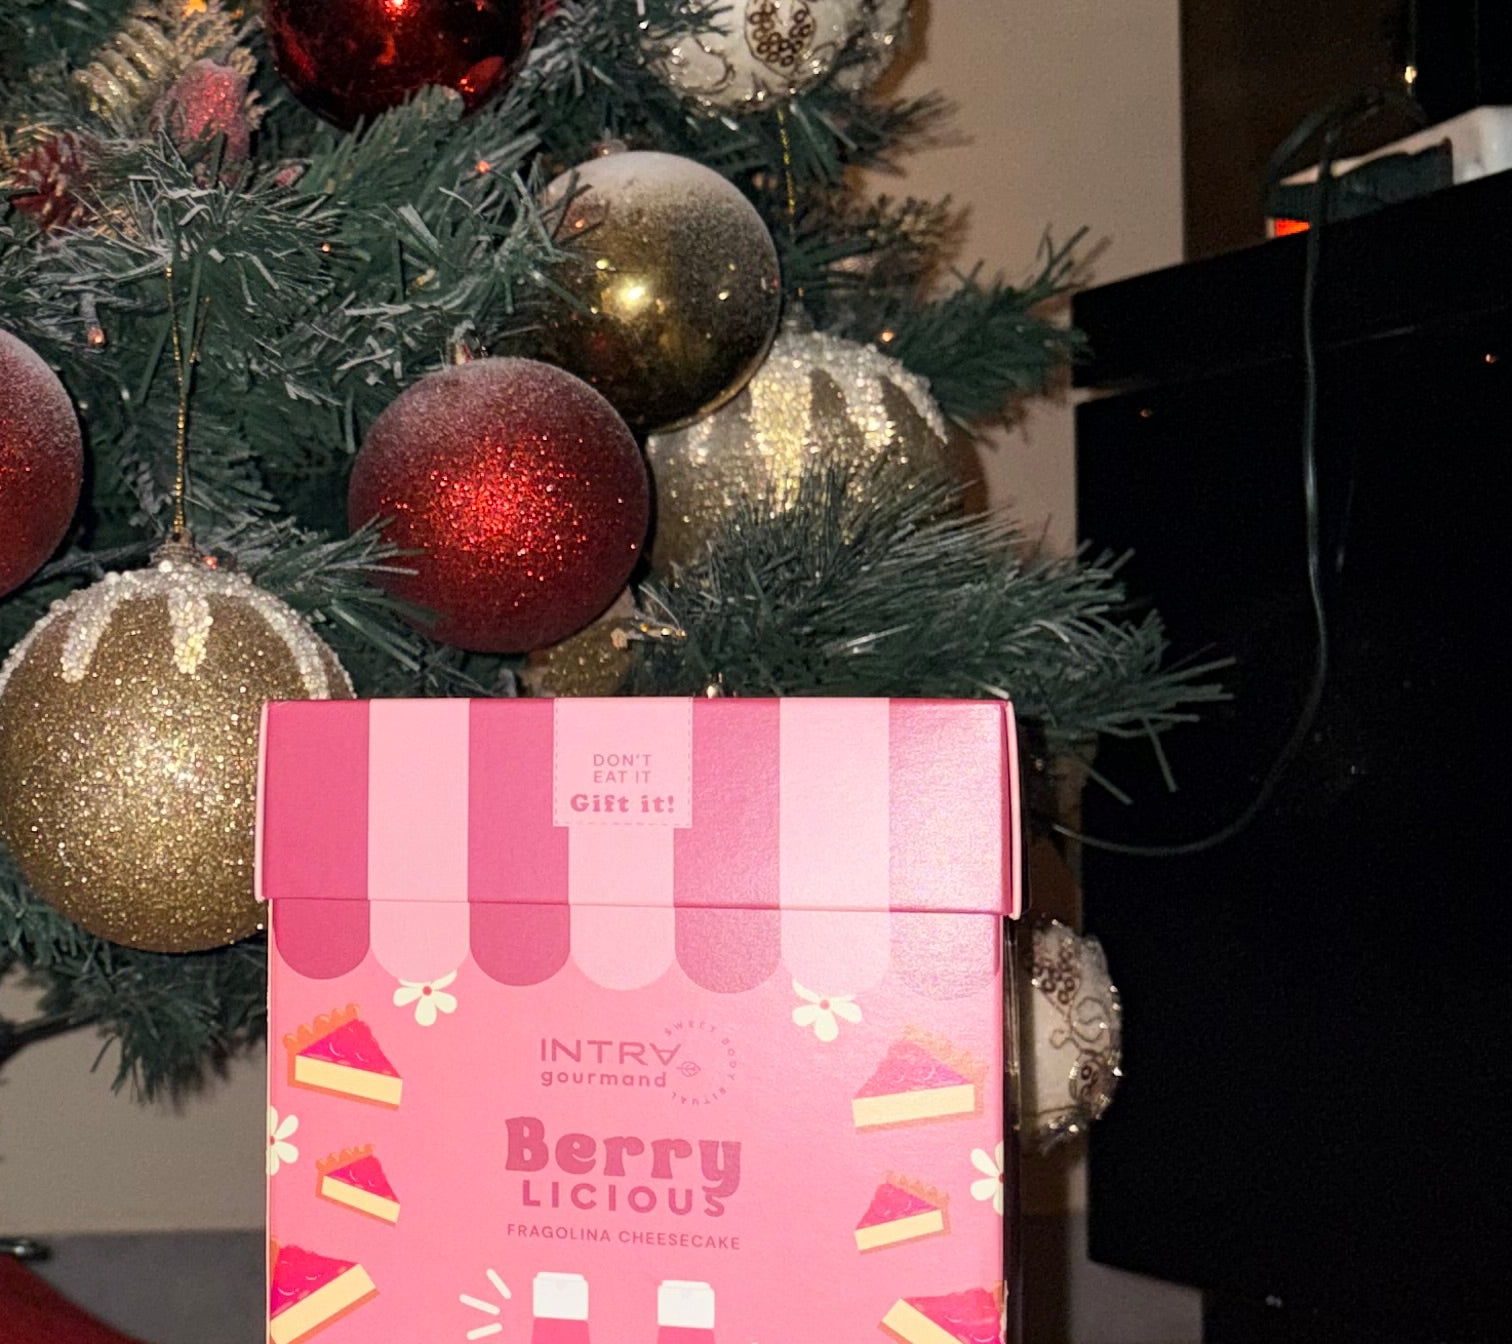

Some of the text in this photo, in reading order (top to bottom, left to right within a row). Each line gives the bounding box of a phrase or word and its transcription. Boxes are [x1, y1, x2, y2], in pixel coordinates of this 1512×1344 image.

[593, 754, 652, 766] DON'T
[594, 771, 651, 783] EAT IT
[571, 794, 674, 813] Gift it!
[665, 1021, 717, 1037] SWEET
[541, 1070, 666, 1087] gourmand
[505, 1116, 741, 1199] Berry
[523, 1180, 725, 1217] LICIOUS
[507, 1224, 741, 1250] FRAGOLINA CHEESECAKE
